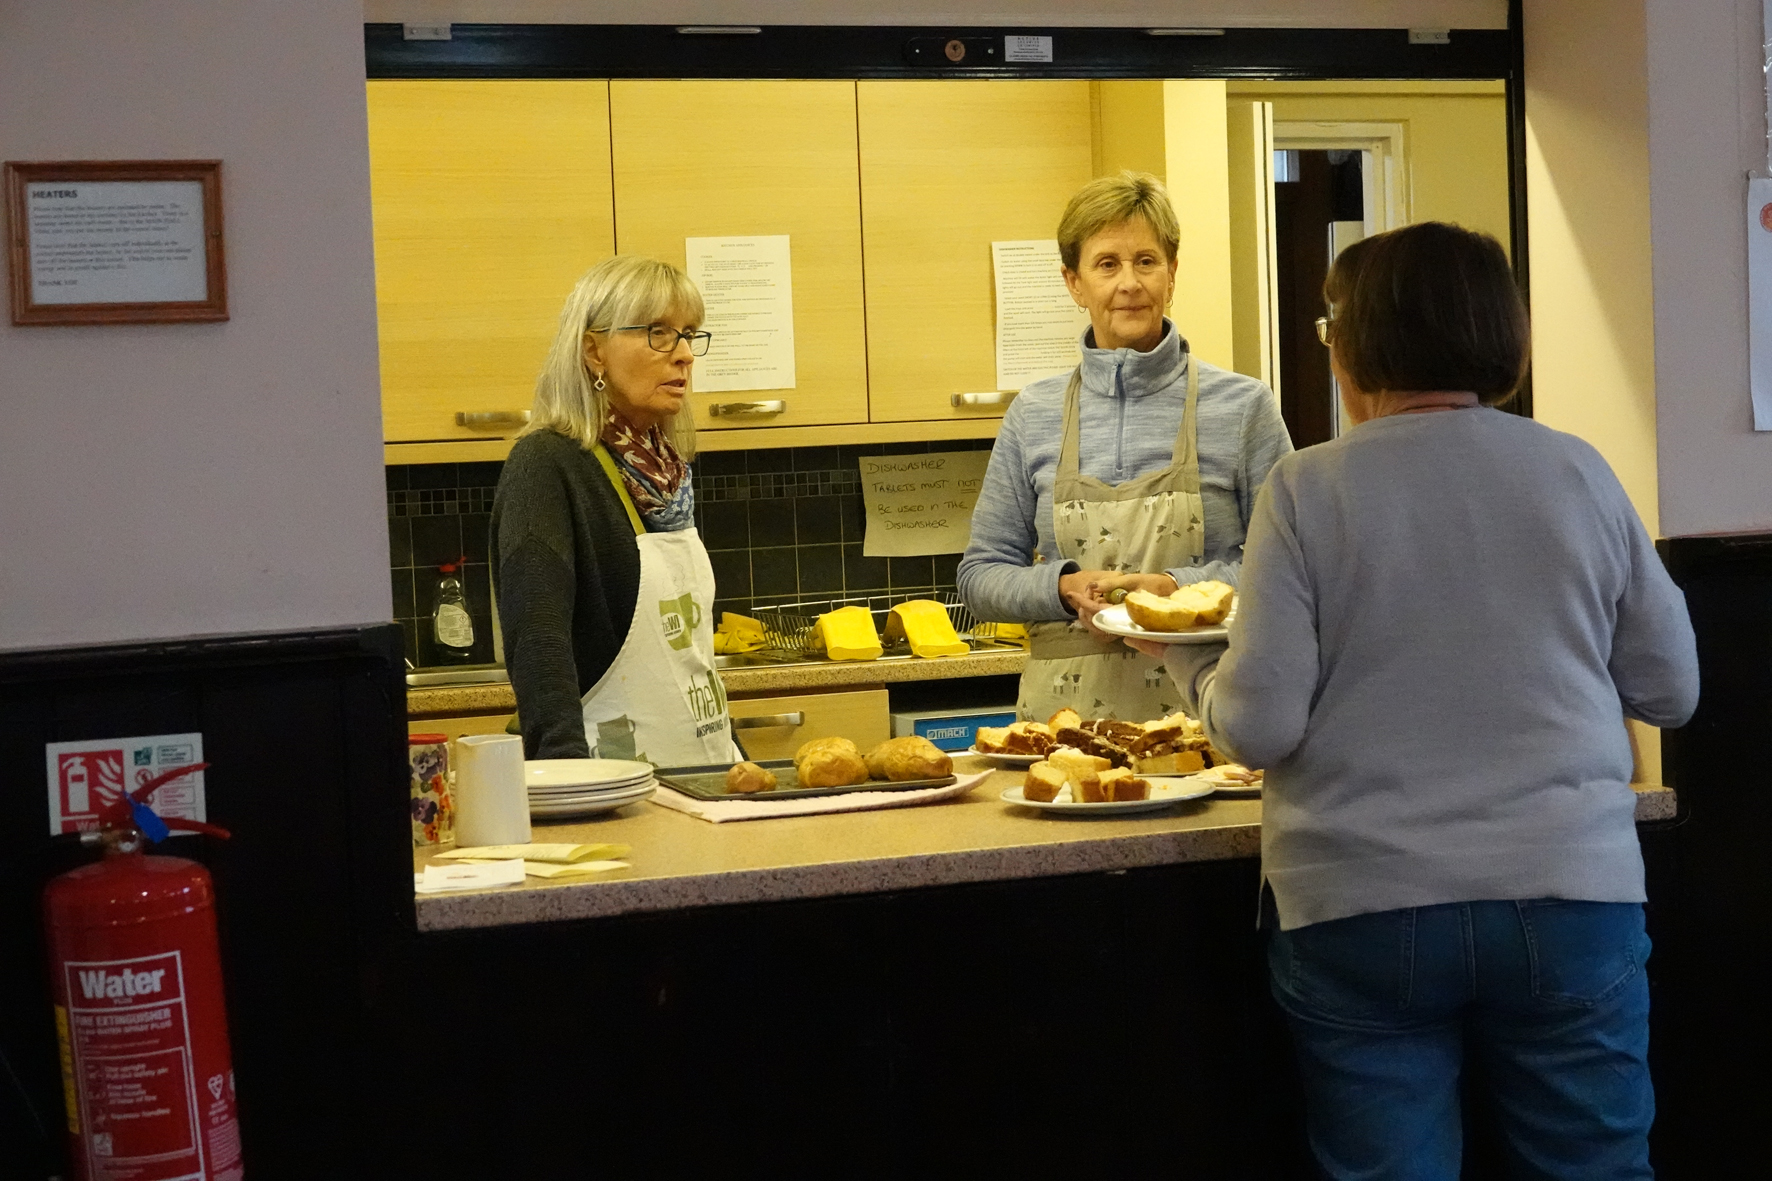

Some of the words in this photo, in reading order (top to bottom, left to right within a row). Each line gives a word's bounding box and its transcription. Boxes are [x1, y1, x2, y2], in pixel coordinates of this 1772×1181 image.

[32, 190, 78, 199] HEATERS
[866, 459, 946, 475] DISHWASHER
[872, 482, 916, 493] TABLETS
[921, 480, 949, 490] MUST
[878, 504, 893, 515] BE
[897, 505, 925, 513] USED
[944, 501, 968, 510] THE
[884, 519, 950, 531] DISHWASHER
[79, 968, 165, 999] Water
[96, 1007, 171, 1027] EXTINGUISHER
